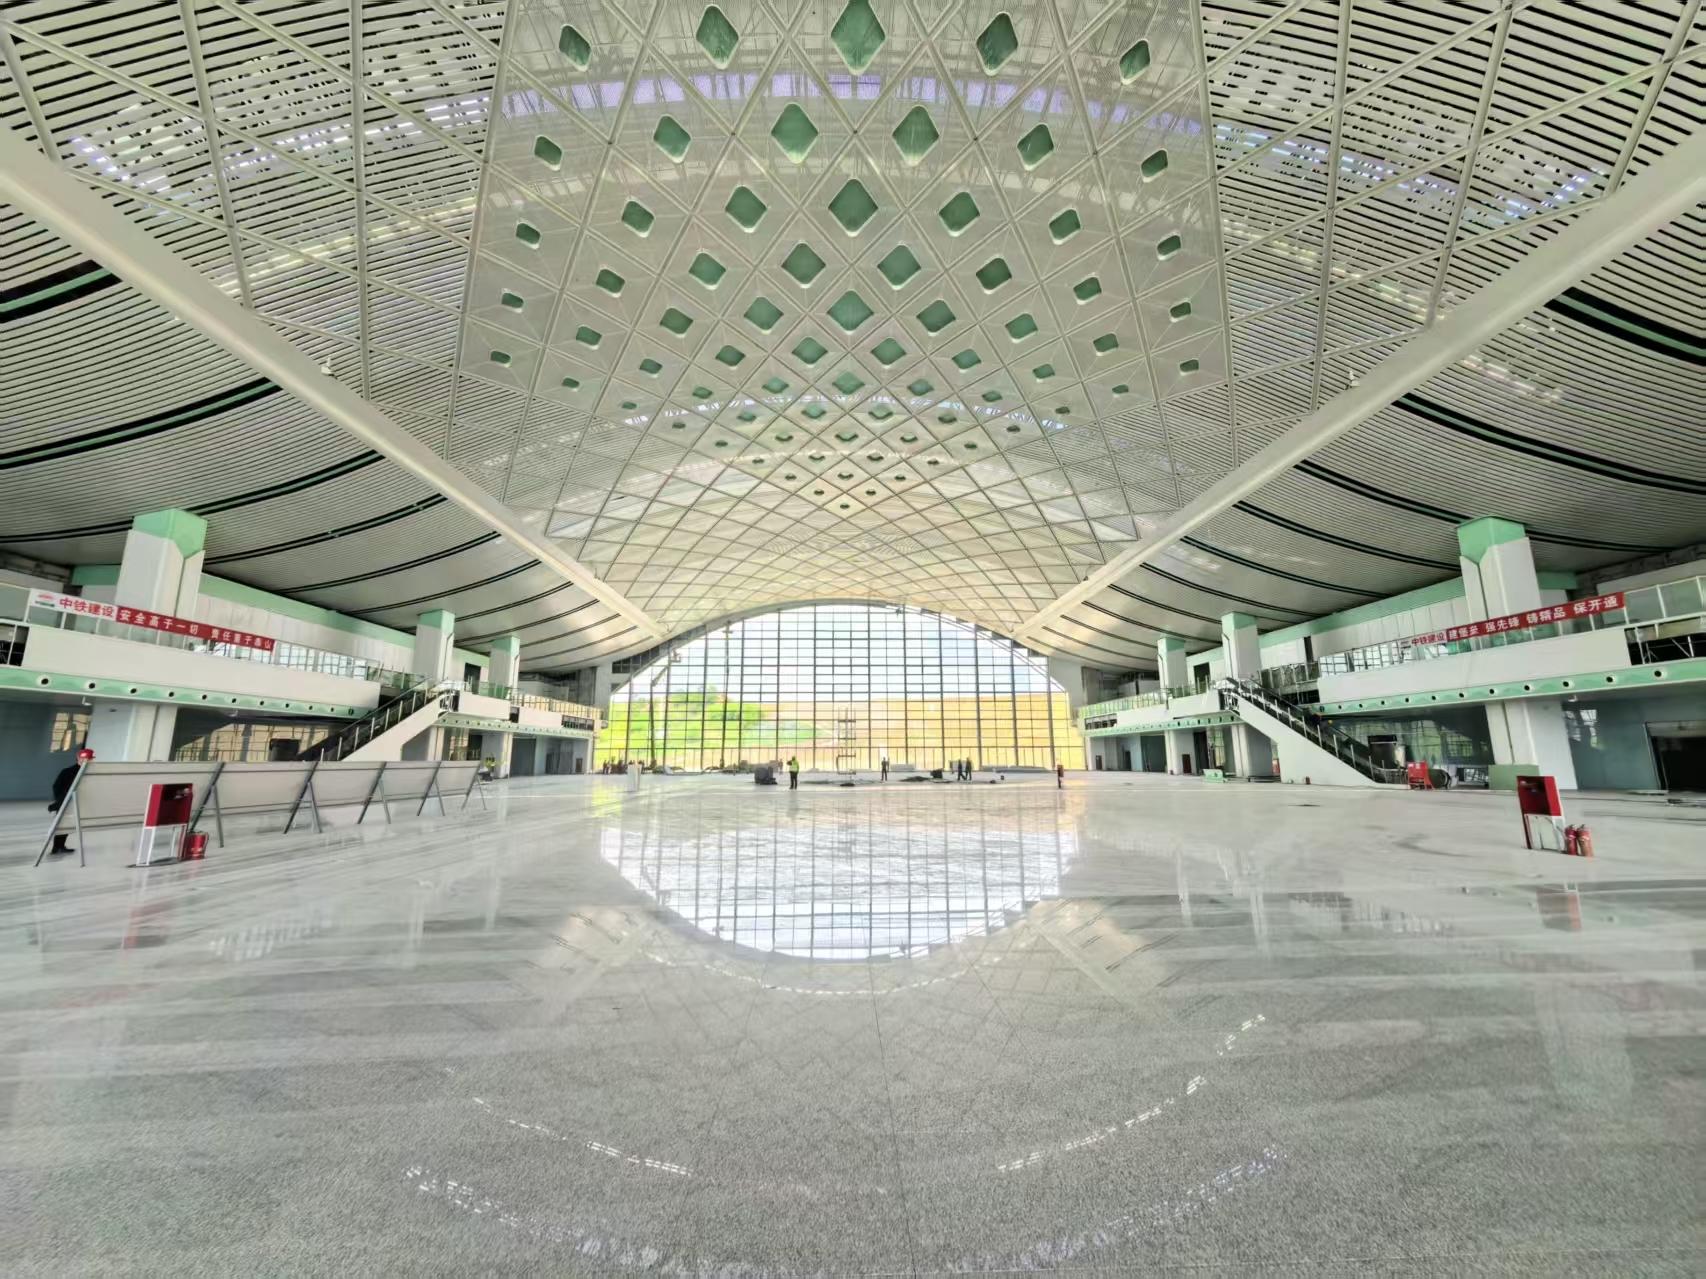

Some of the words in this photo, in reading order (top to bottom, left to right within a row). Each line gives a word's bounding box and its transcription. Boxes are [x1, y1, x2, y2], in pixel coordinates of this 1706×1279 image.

[59, 597, 115, 618] 中铁建设
[120, 609, 199, 635] 安全高于一切
[1411, 632, 1445, 646] 中铁建设
[1485, 615, 1520, 633] 强先锋
[1526, 606, 1567, 625] 铸精品
[1573, 595, 1618, 614] 保开通
